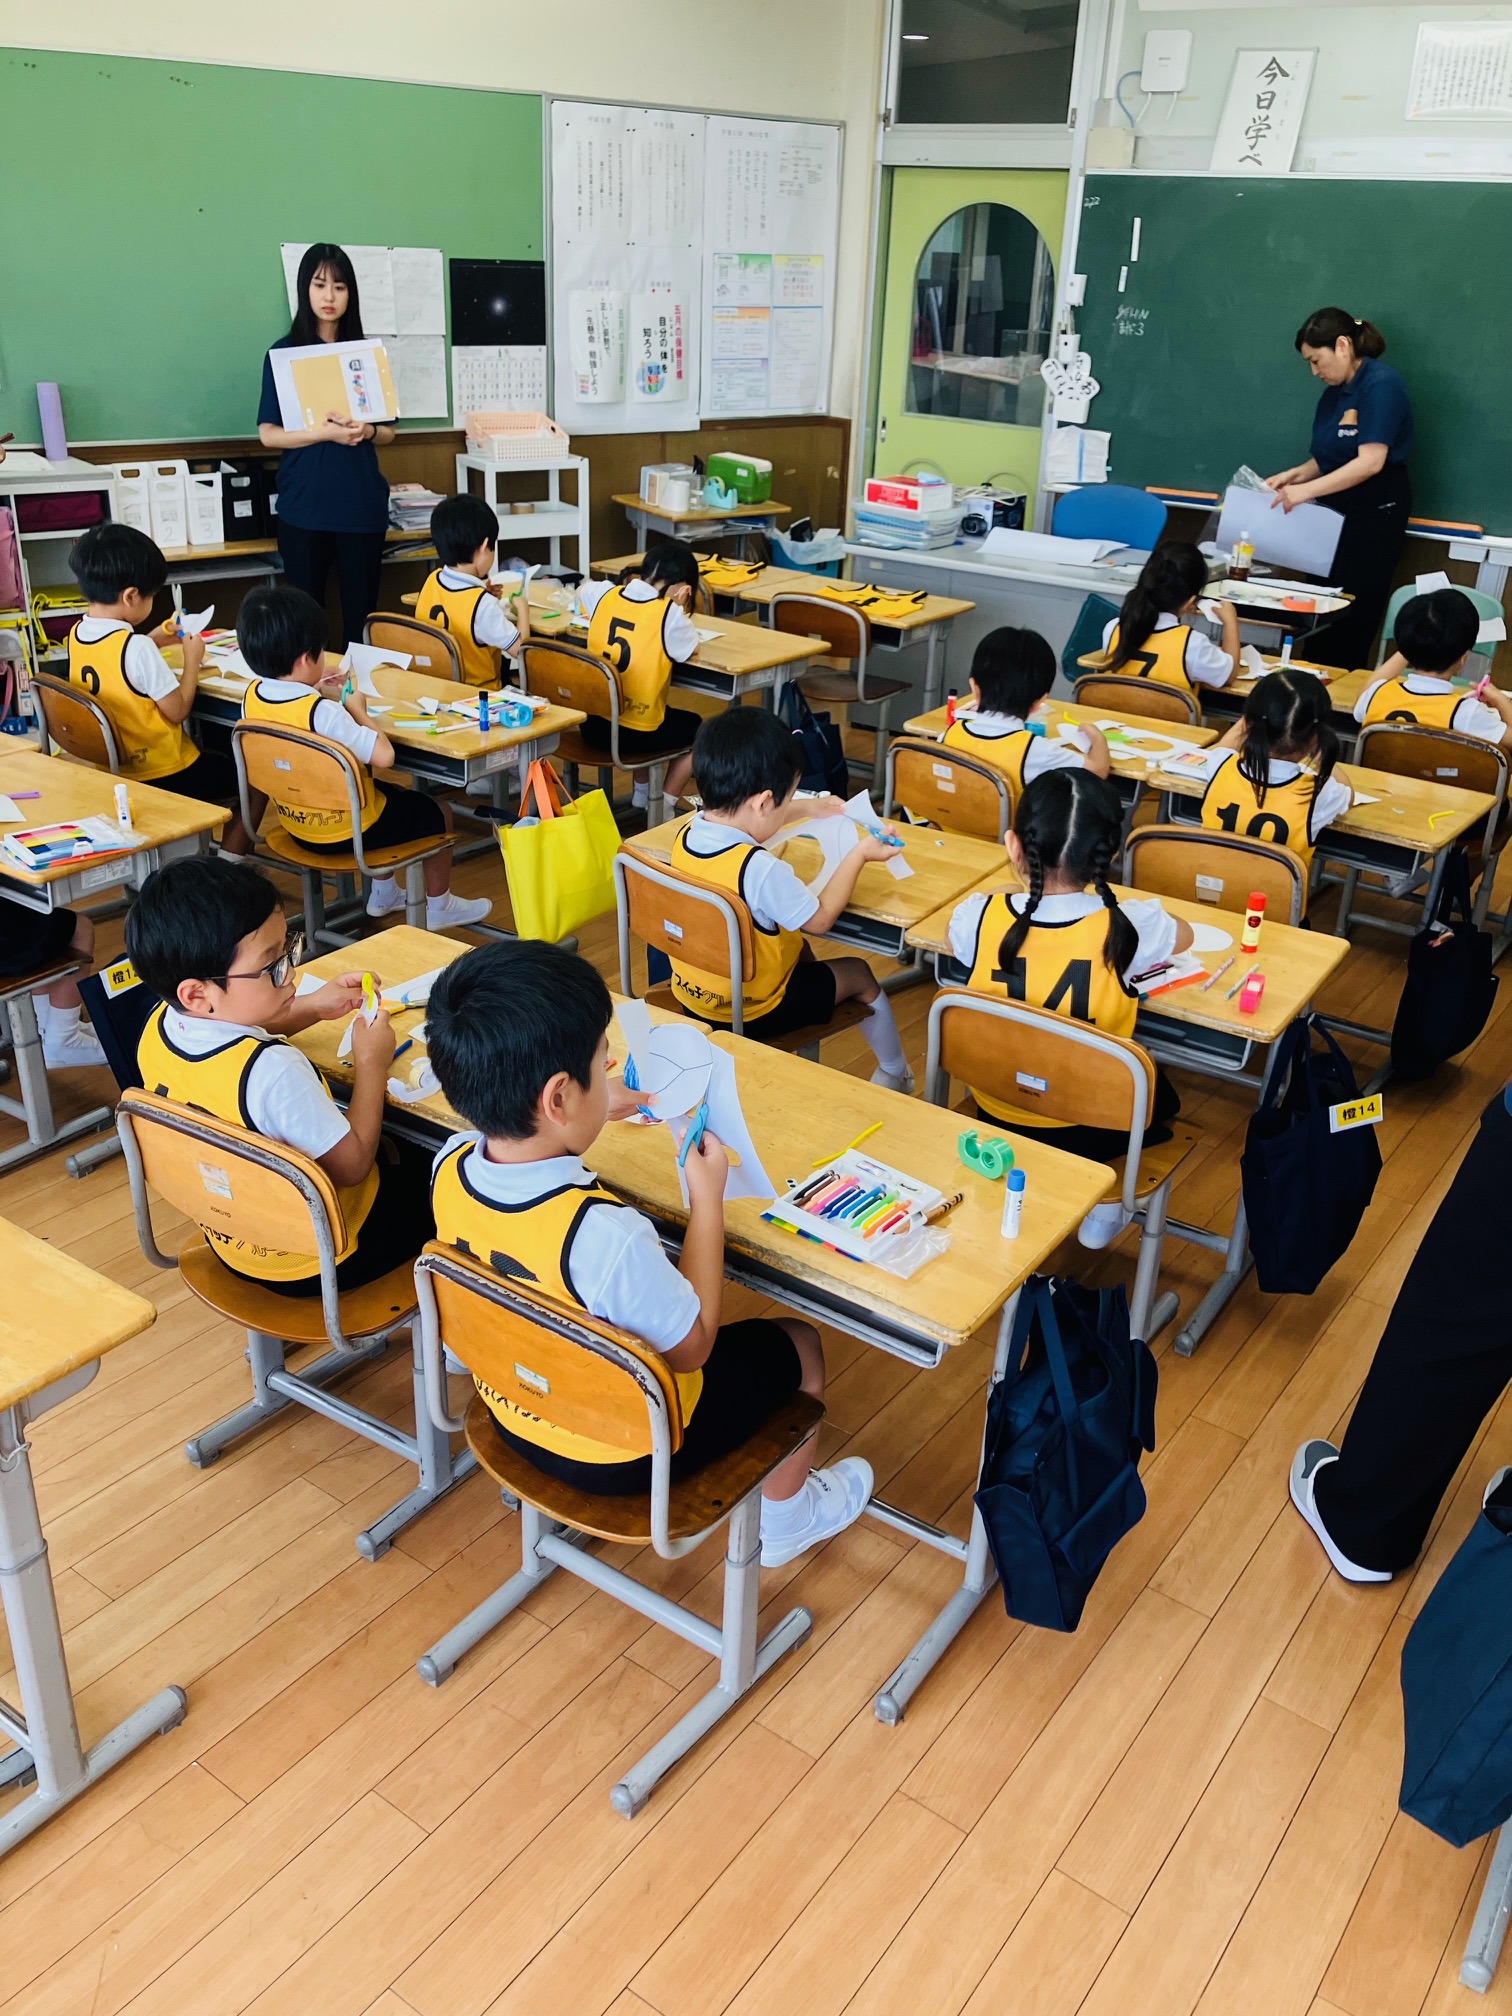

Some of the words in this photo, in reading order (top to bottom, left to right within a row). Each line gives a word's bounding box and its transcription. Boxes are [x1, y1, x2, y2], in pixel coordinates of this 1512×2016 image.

[1238, 56, 1290, 166] 今日学べ
[163, 527, 177, 542] 2
[203, 523, 214, 539] 3
[602, 616, 636, 673] 5
[990, 957, 1097, 1025] 14
[1342, 1102, 1376, 1121] 橙14
[209, 1205, 232, 1219] KOKUYO
[518, 1381, 544, 1399] KOKUYO
